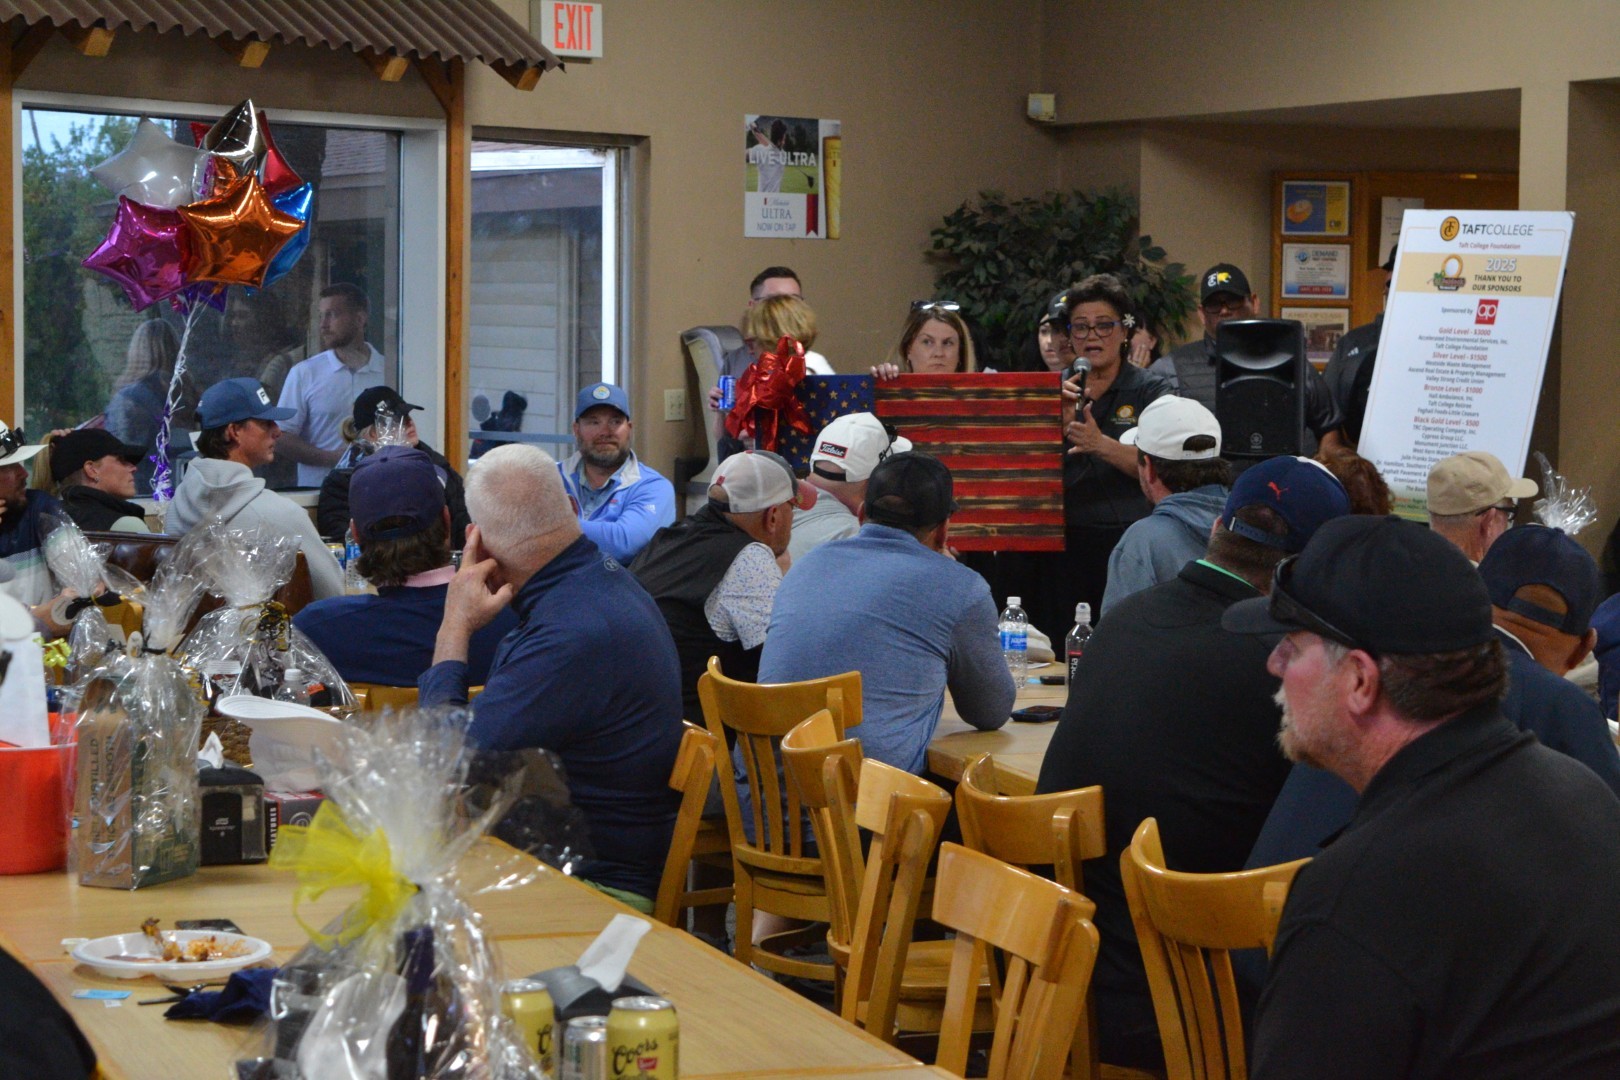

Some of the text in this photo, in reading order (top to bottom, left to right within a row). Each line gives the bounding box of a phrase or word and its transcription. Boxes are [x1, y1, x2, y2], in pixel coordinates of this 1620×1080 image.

[554, 2, 593, 51] EXIT
[748, 150, 817, 166] LIVE ULTRA
[762, 208, 792, 220] ULTRA
[756, 223, 772, 231] NOW
[784, 223, 796, 232] TAP
[1470, 242, 1489, 250] College
[1485, 258, 1518, 272] 2025
[1474, 274, 1496, 282] THANK
[1514, 275, 1522, 283] TO
[1461, 362, 1492, 370] Management
[1424, 384, 1444, 392] Bronze
[1445, 418, 1461, 426] Level
[612, 1038, 658, 1076] Coors
